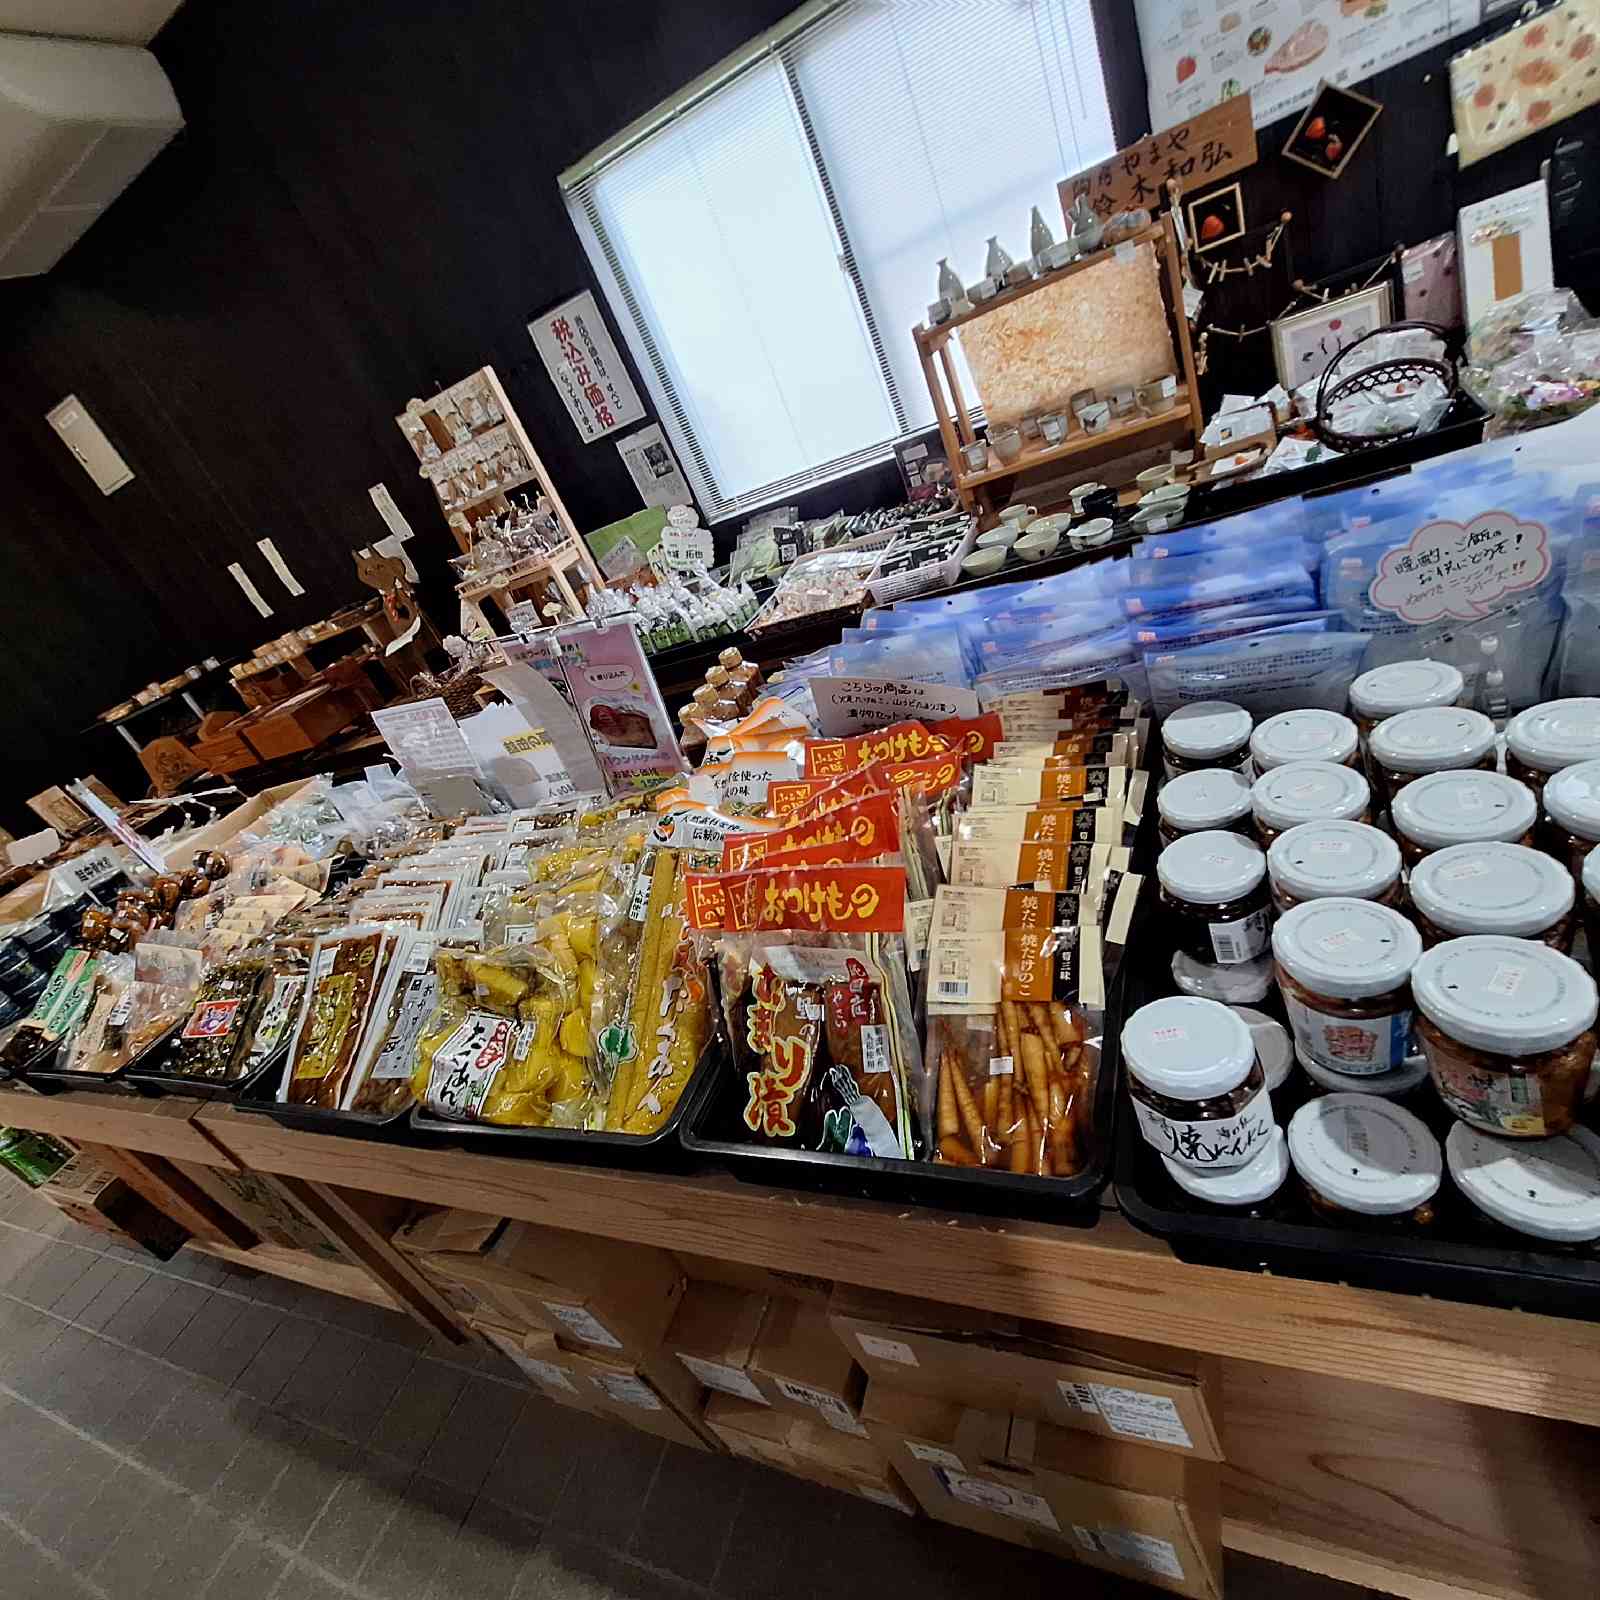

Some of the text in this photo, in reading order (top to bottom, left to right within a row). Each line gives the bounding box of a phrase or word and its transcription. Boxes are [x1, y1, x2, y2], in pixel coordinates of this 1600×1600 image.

[550, 316, 615, 431] 税込み価格
[841, 682, 925, 696] こちらの商品は
[763, 877, 880, 924] おつけもの
[1017, 934, 1039, 997] 焼たけのこ
[1170, 1118, 1269, 1163] 焼にんにく
